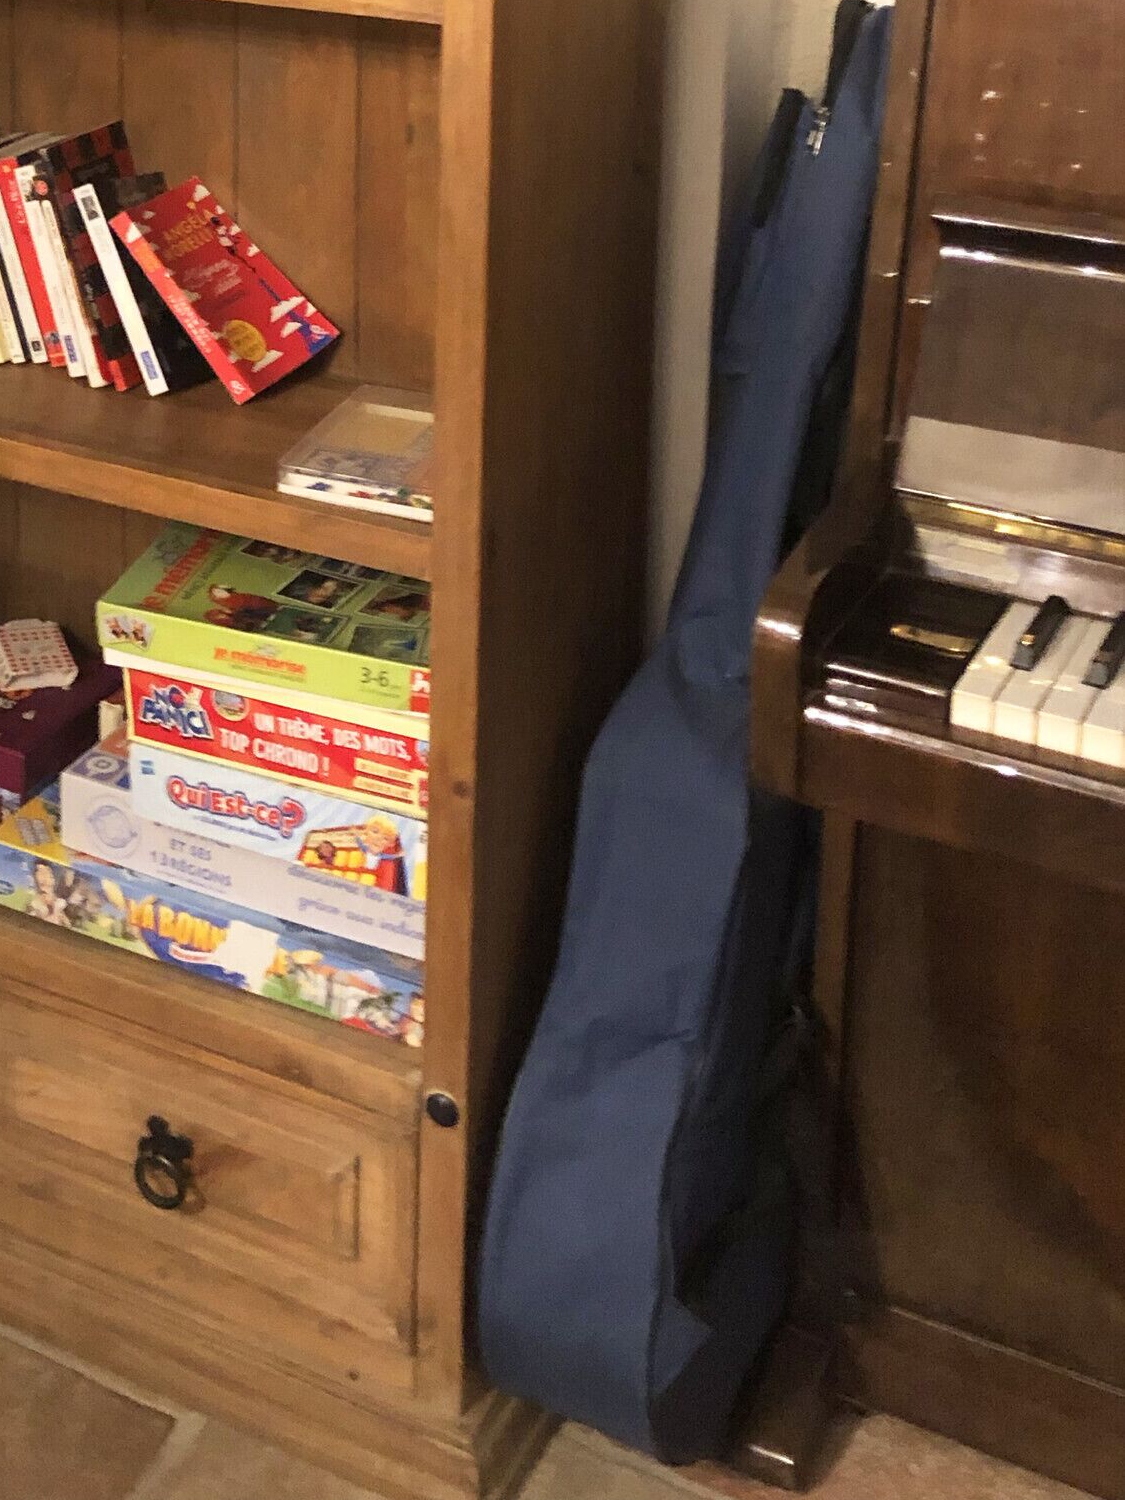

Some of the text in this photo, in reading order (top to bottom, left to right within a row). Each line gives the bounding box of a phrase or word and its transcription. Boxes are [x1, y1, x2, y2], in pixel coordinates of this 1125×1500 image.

[219, 727, 251, 754] TOP
[252, 738, 319, 775] CHRONO
[254, 712, 275, 734] UN
[331, 728, 362, 750] DES
